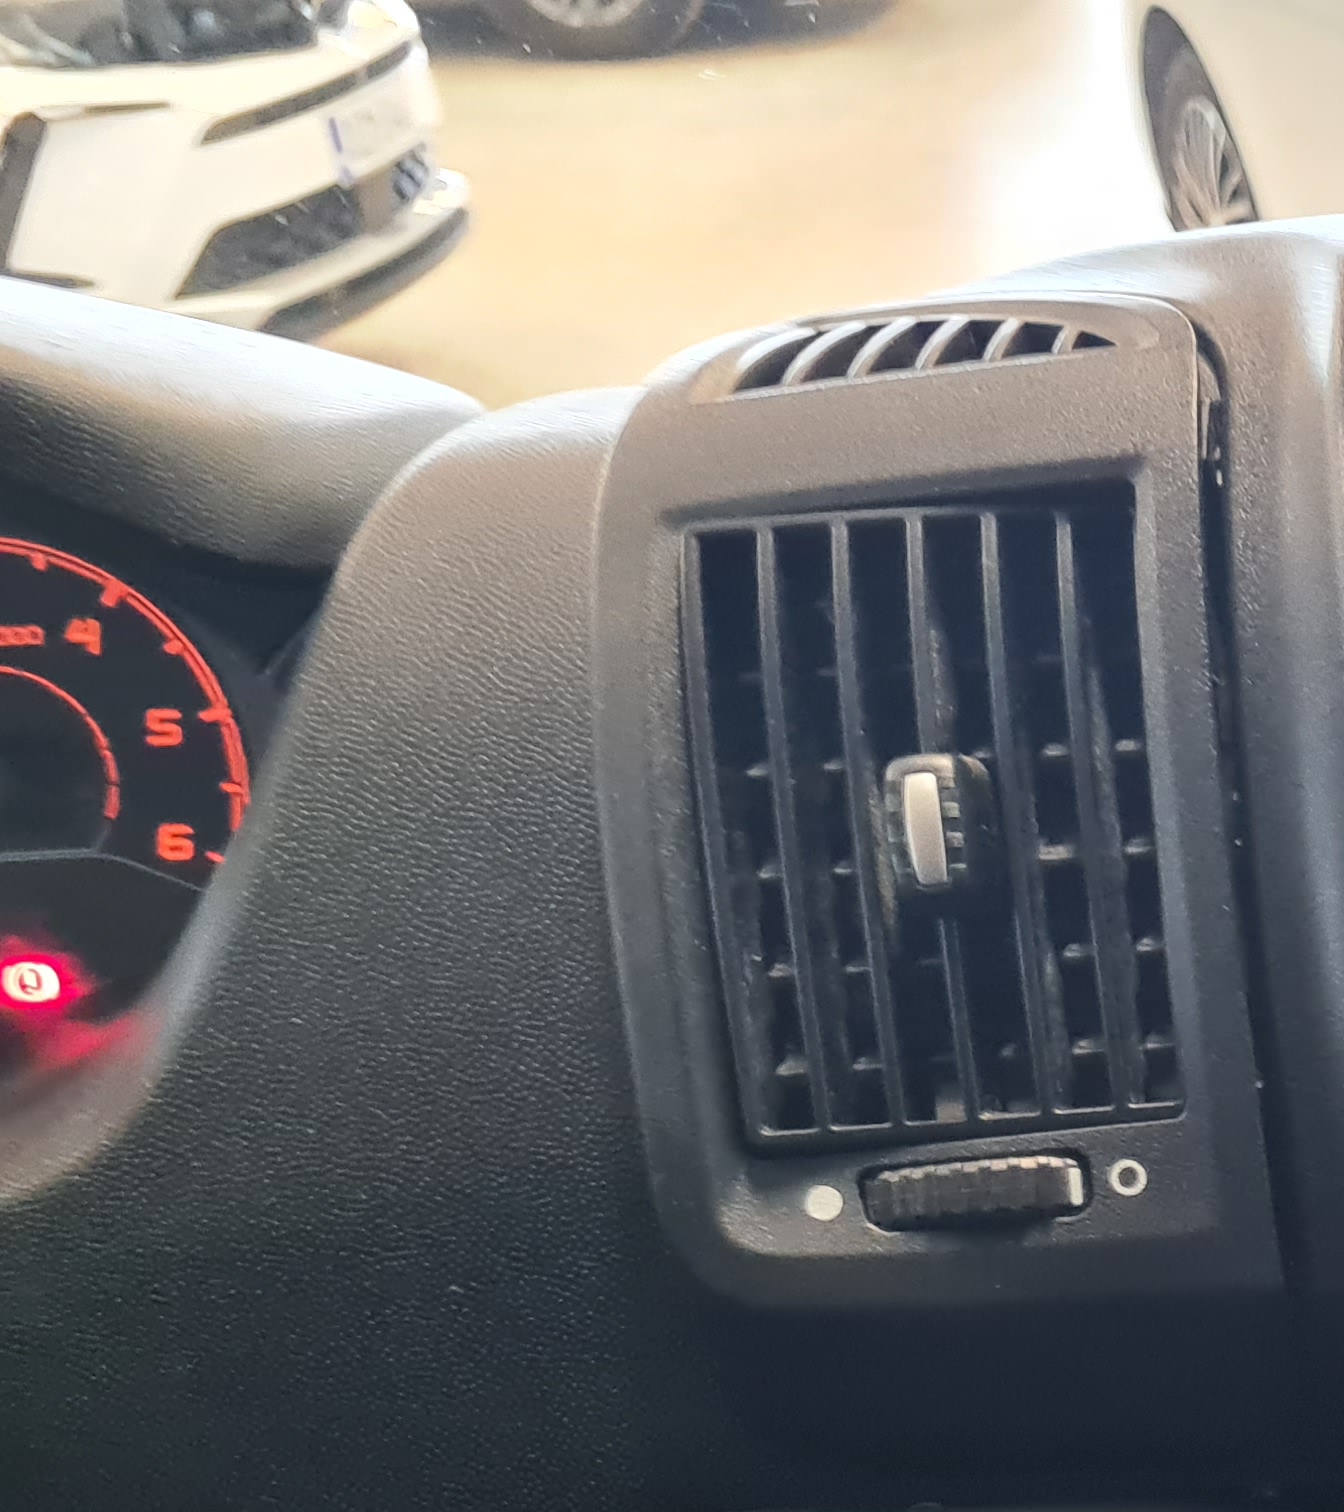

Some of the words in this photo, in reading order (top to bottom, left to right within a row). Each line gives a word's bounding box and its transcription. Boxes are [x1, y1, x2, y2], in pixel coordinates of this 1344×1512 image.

[64, 617, 103, 655] 4
[144, 708, 183, 747] 5
[155, 822, 195, 862] 6
